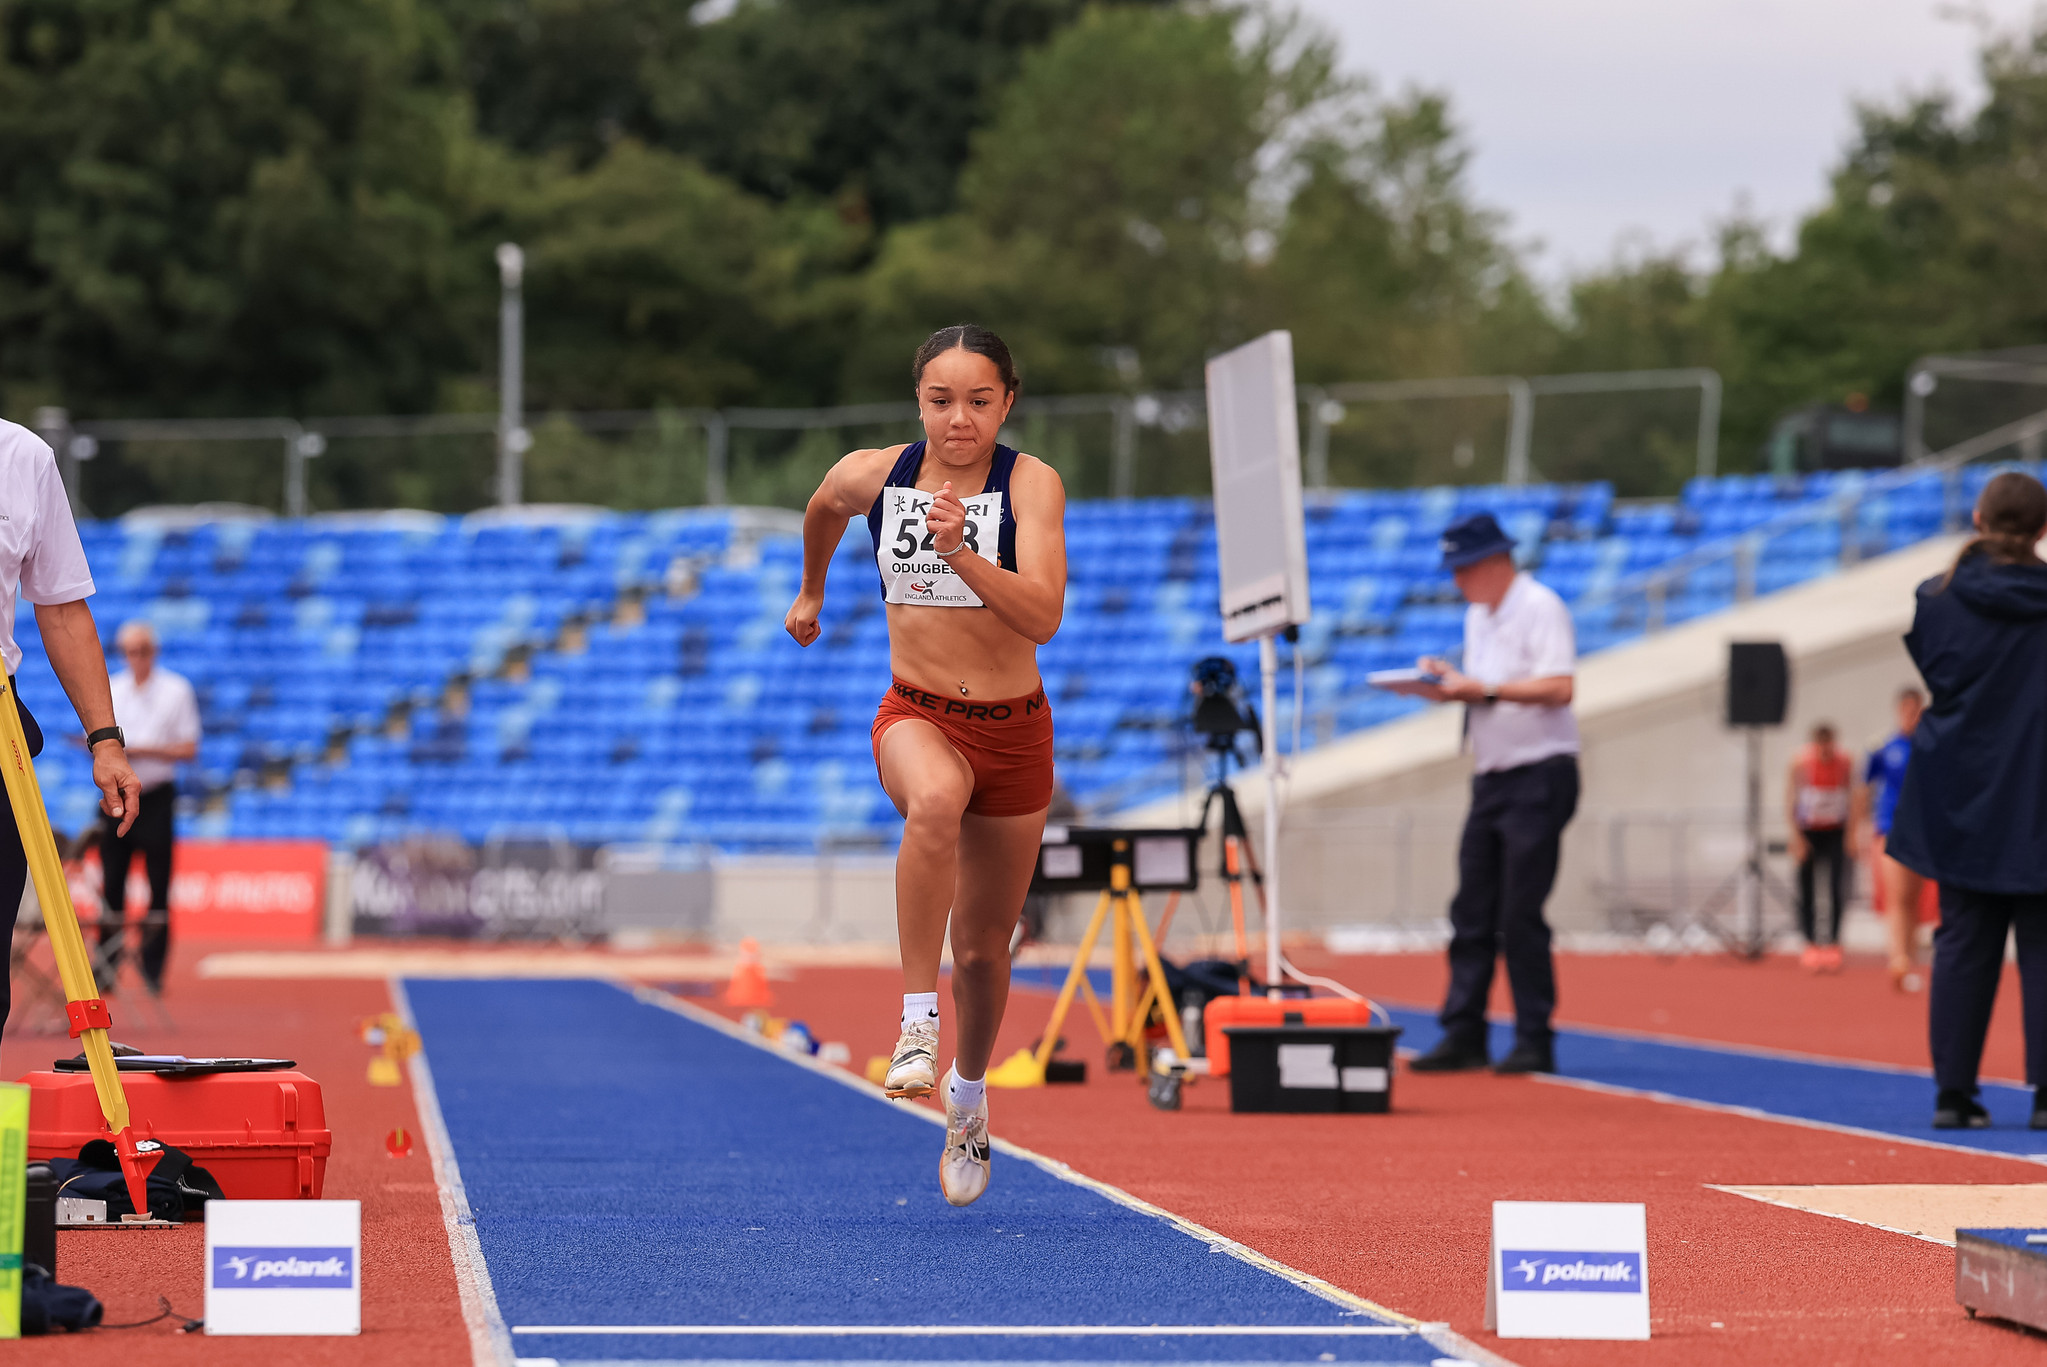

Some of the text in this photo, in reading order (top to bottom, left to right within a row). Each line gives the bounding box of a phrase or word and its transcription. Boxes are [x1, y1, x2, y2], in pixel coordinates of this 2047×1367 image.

[911, 498, 989, 517] KRI
[891, 562, 958, 575] ODUGBE
[904, 592, 967, 602] ENGLAND ATHLETICS
[944, 701, 1012, 721] PRO
[252, 1256, 346, 1282] polanik
[1541, 1259, 1633, 1285] polanik
